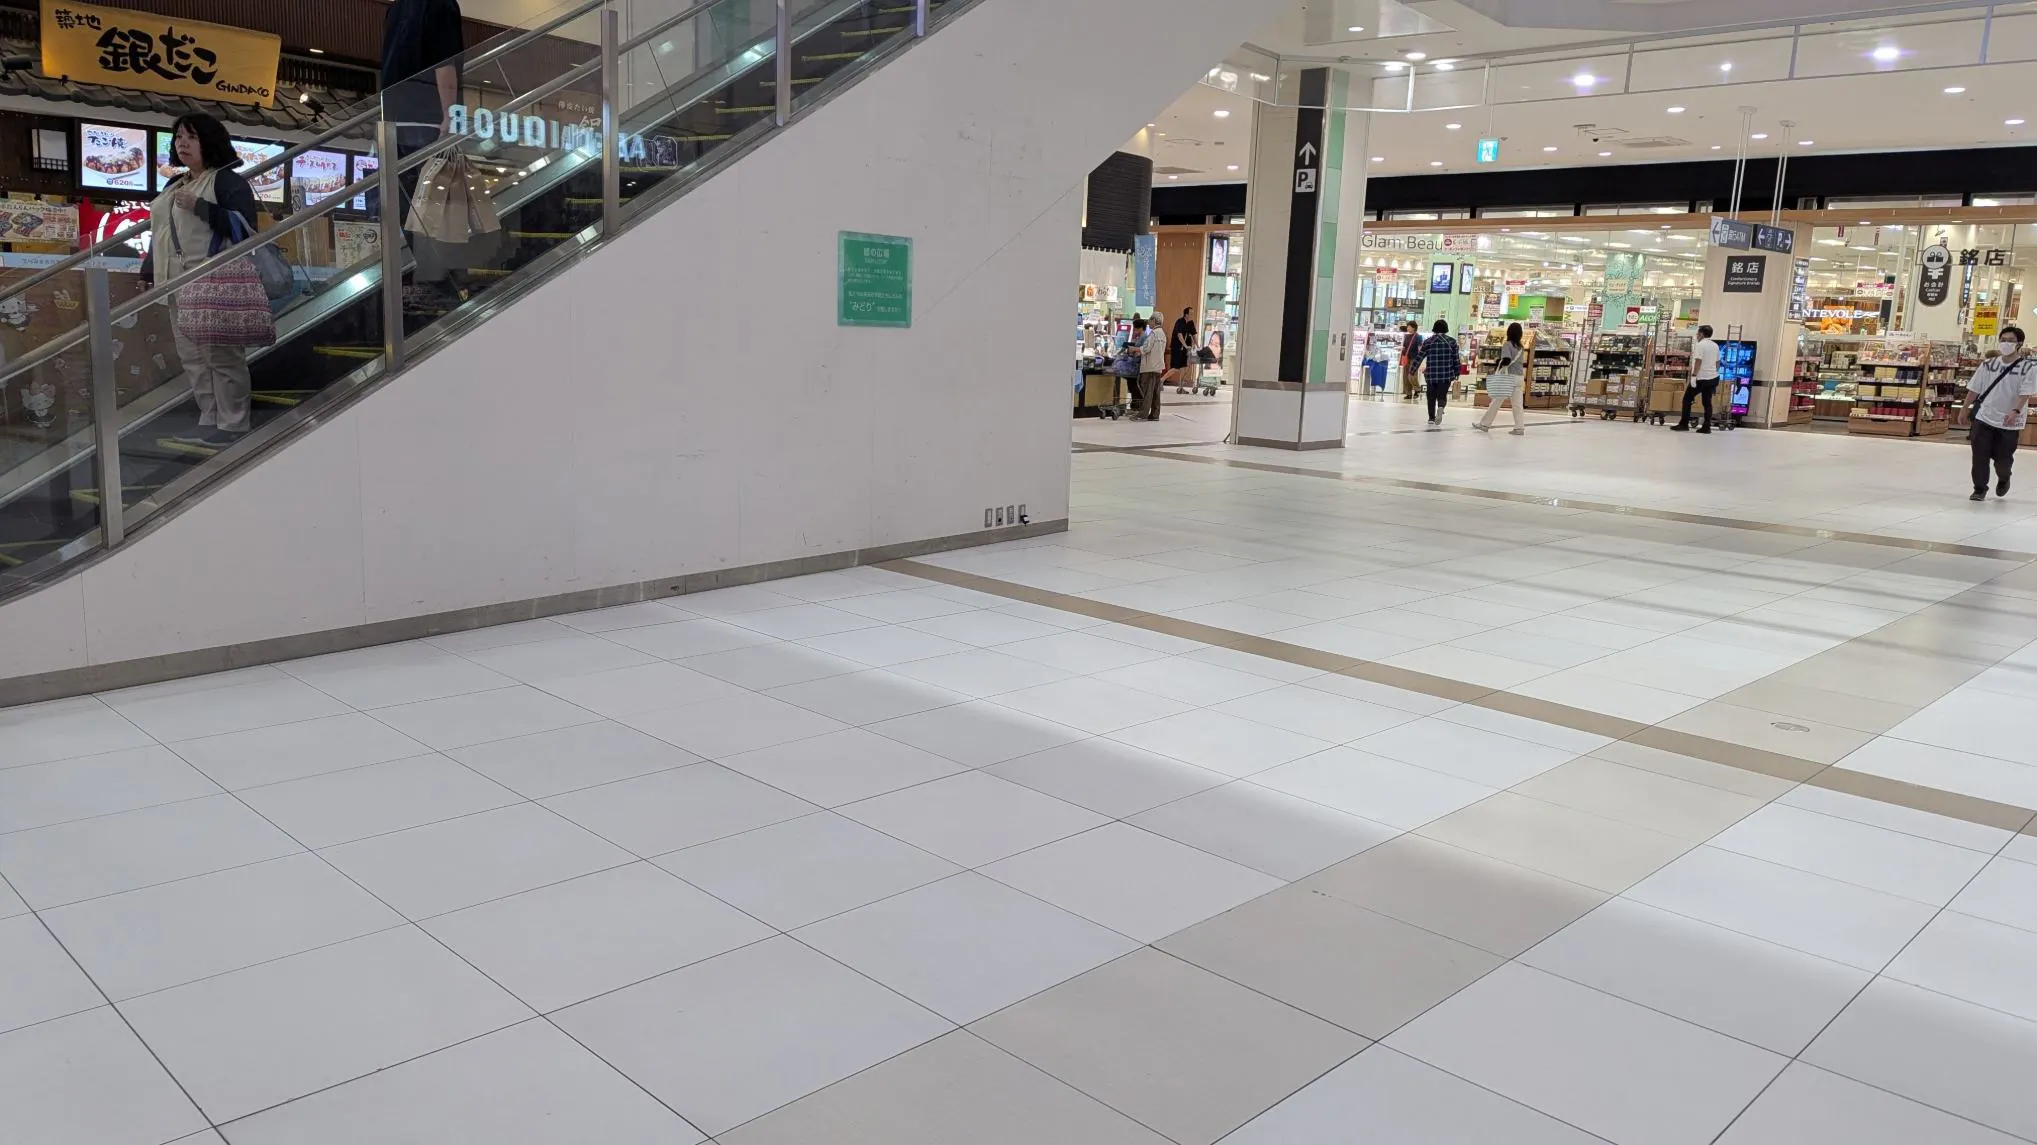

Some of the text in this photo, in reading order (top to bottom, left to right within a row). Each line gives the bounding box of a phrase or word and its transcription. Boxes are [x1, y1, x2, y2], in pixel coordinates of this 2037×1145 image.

[55, 8, 102, 30] 築地
[96, 26, 218, 85] 銀だこ
[215, 79, 270, 98] GINDACO
[1297, 171, 1309, 188] P
[1361, 234, 1401, 248] Glam
[1959, 249, 2006, 266] 銘店
[1731, 262, 1759, 274] 銘店
